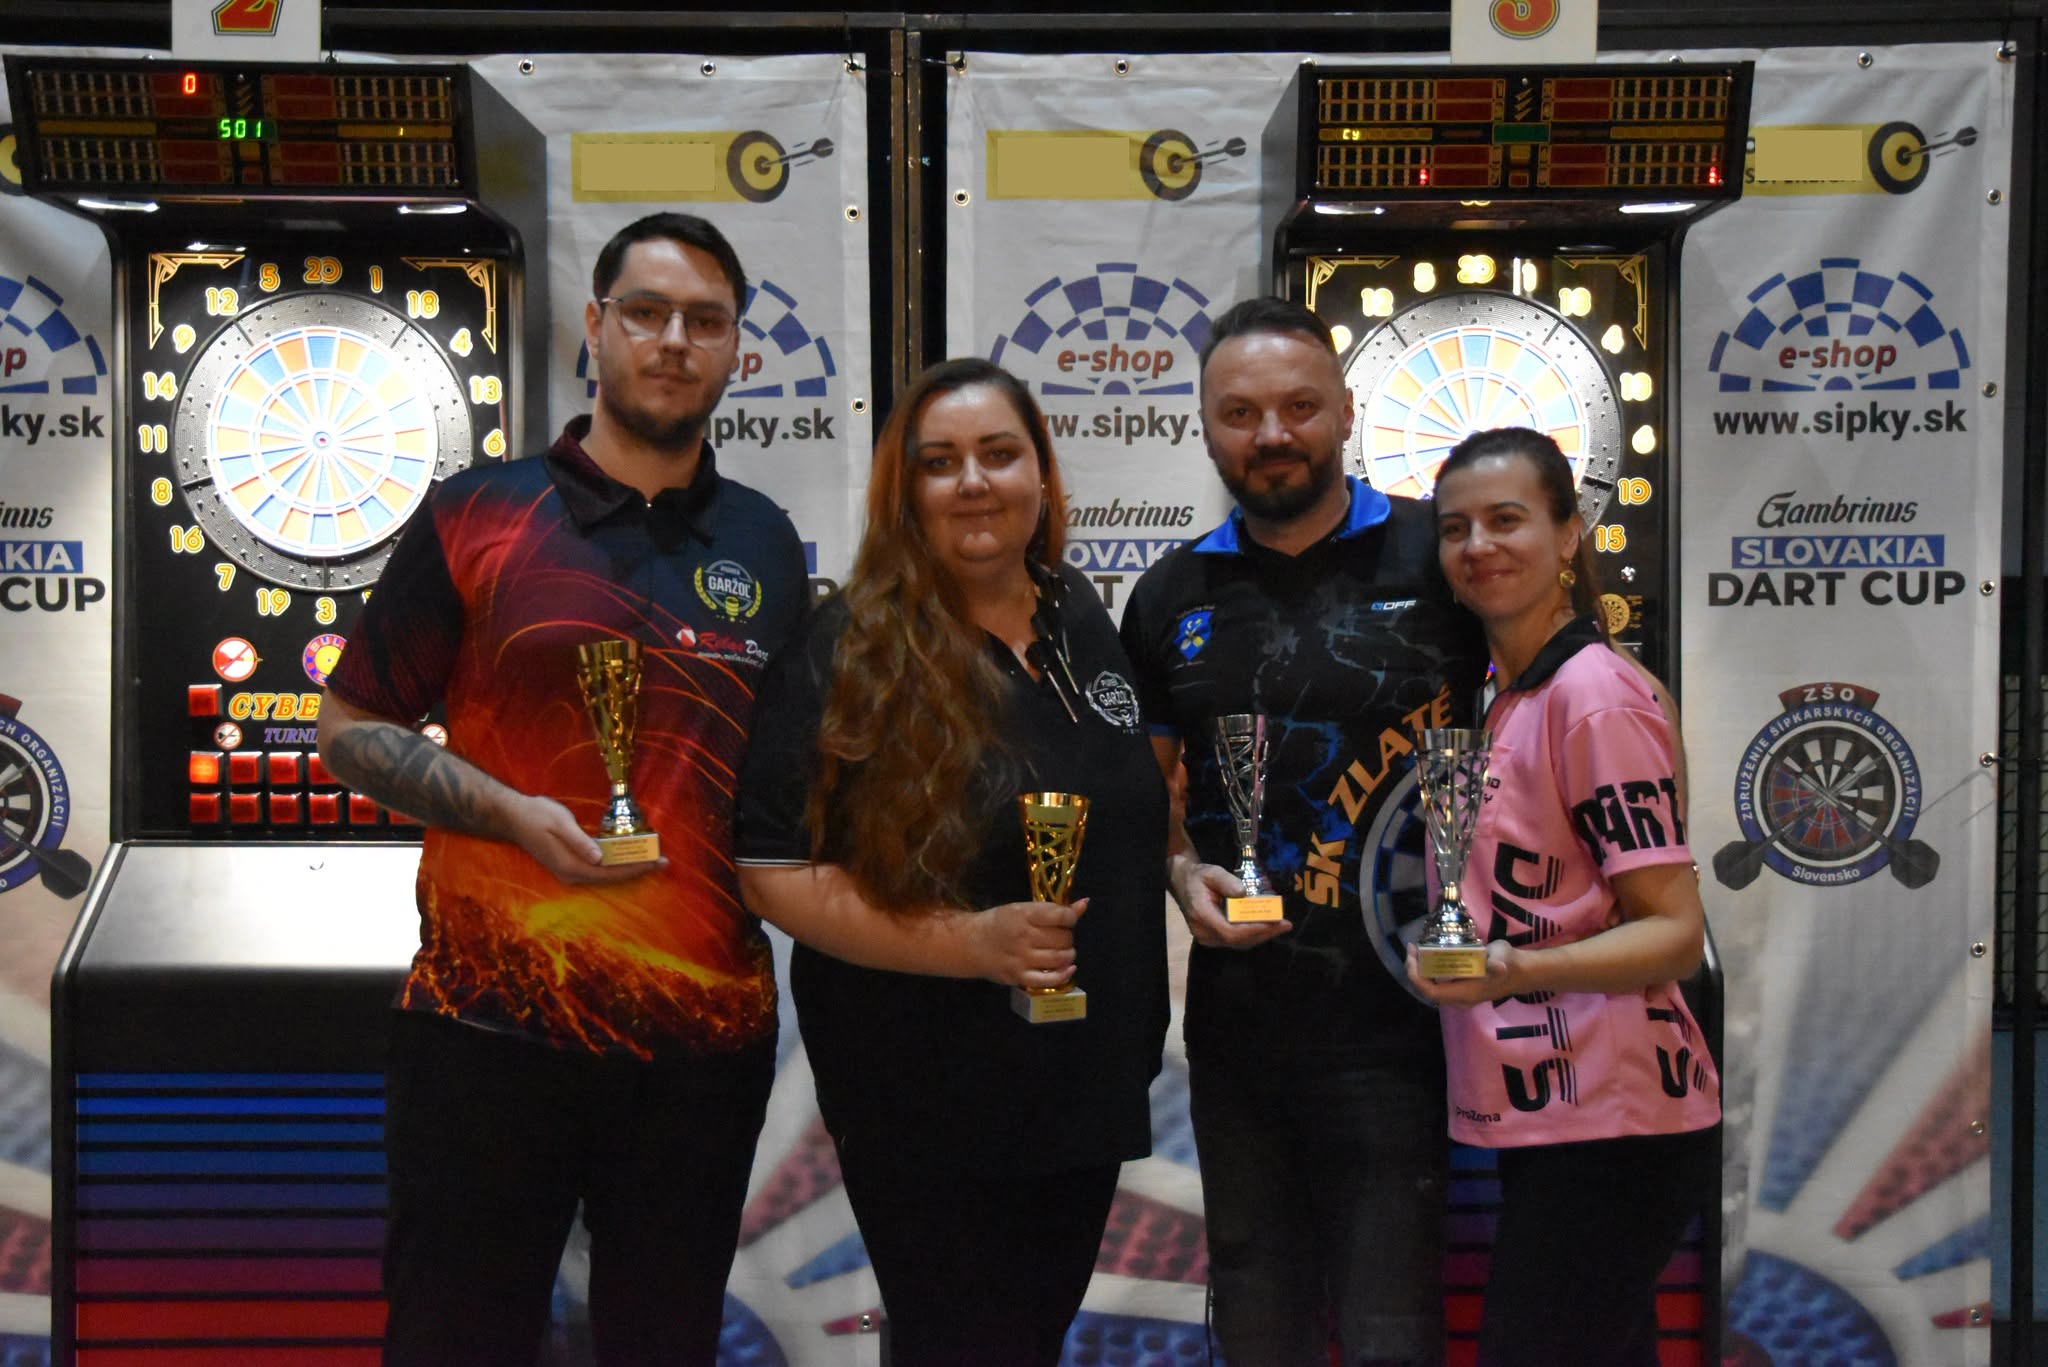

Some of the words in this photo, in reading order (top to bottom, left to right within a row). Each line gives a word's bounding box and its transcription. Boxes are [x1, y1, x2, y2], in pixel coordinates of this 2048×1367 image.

[183, 73, 197, 94] 0
[219, 118, 262, 139] 501
[260, 263, 280, 292] 5
[304, 256, 343, 283] 20
[369, 265, 383, 293] 1
[206, 287, 239, 315] 12
[406, 290, 440, 319] 18
[172, 324, 196, 353] 9
[449, 328, 474, 357] 4
[1058, 343, 1174, 379] e-shop
[1779, 339, 1897, 373] e-shop
[143, 371, 178, 401] 14
[469, 375, 502, 404] 13
[1713, 400, 1968, 441] www.sipky.sk
[138, 424, 168, 453] 11
[483, 428, 506, 457] 6
[152, 477, 173, 506] 8
[1618, 477, 1652, 505] 10
[1066, 498, 1194, 528] ambrinus
[1757, 490, 1919, 529] Gambrinus
[170, 525, 205, 553] 16
[1596, 524, 1627, 552] 15
[1740, 537, 1936, 566] SLOVAKIA
[0, 543, 75, 571] KIA
[215, 563, 236, 591] 7
[1708, 572, 1846, 606] DART
[1861, 570, 1966, 606] CUP
[0, 576, 106, 612] CUP
[256, 588, 291, 616] 19
[315, 596, 336, 625] 3
[1804, 682, 1855, 702] ZŠO
[1792, 865, 1861, 883] Slovensko
